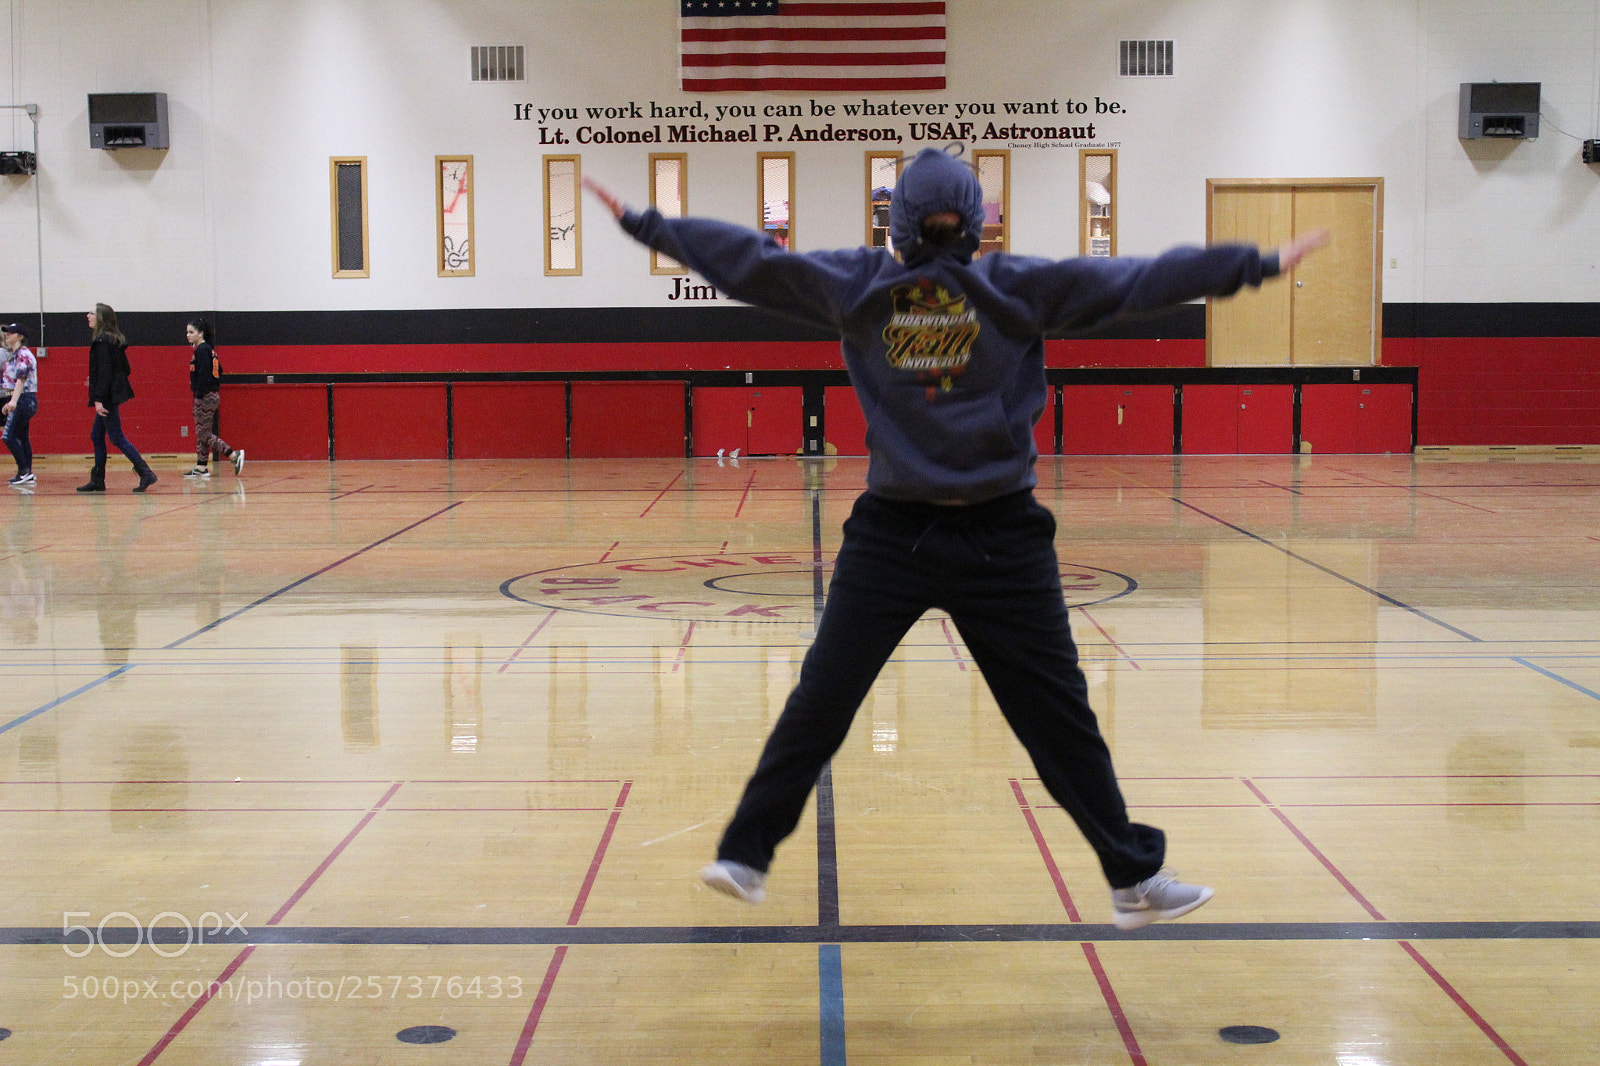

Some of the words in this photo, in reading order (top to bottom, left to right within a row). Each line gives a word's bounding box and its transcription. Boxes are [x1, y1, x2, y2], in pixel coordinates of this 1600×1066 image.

[513, 103, 533, 121] If
[537, 107, 579, 125] you
[585, 101, 644, 120] work
[648, 100, 709, 121] hard,
[715, 105, 757, 123] you
[763, 104, 805, 118] can
[809, 98, 836, 117] be
[842, 98, 949, 117] whatever
[954, 102, 997, 119] you
[1002, 98, 1060, 116] want
[1065, 98, 1088, 115] to
[1094, 96, 1127, 114] be.
[538, 127, 570, 145] Lt.
[575, 125, 662, 145] Colonel
[666, 123, 758, 143] Michael
[763, 125, 784, 143] P.
[786, 123, 903, 145] Anderson,
[908, 121, 978, 144] USAF,
[980, 121, 1096, 140] Astronaut
[667, 277, 718, 301] Jim
